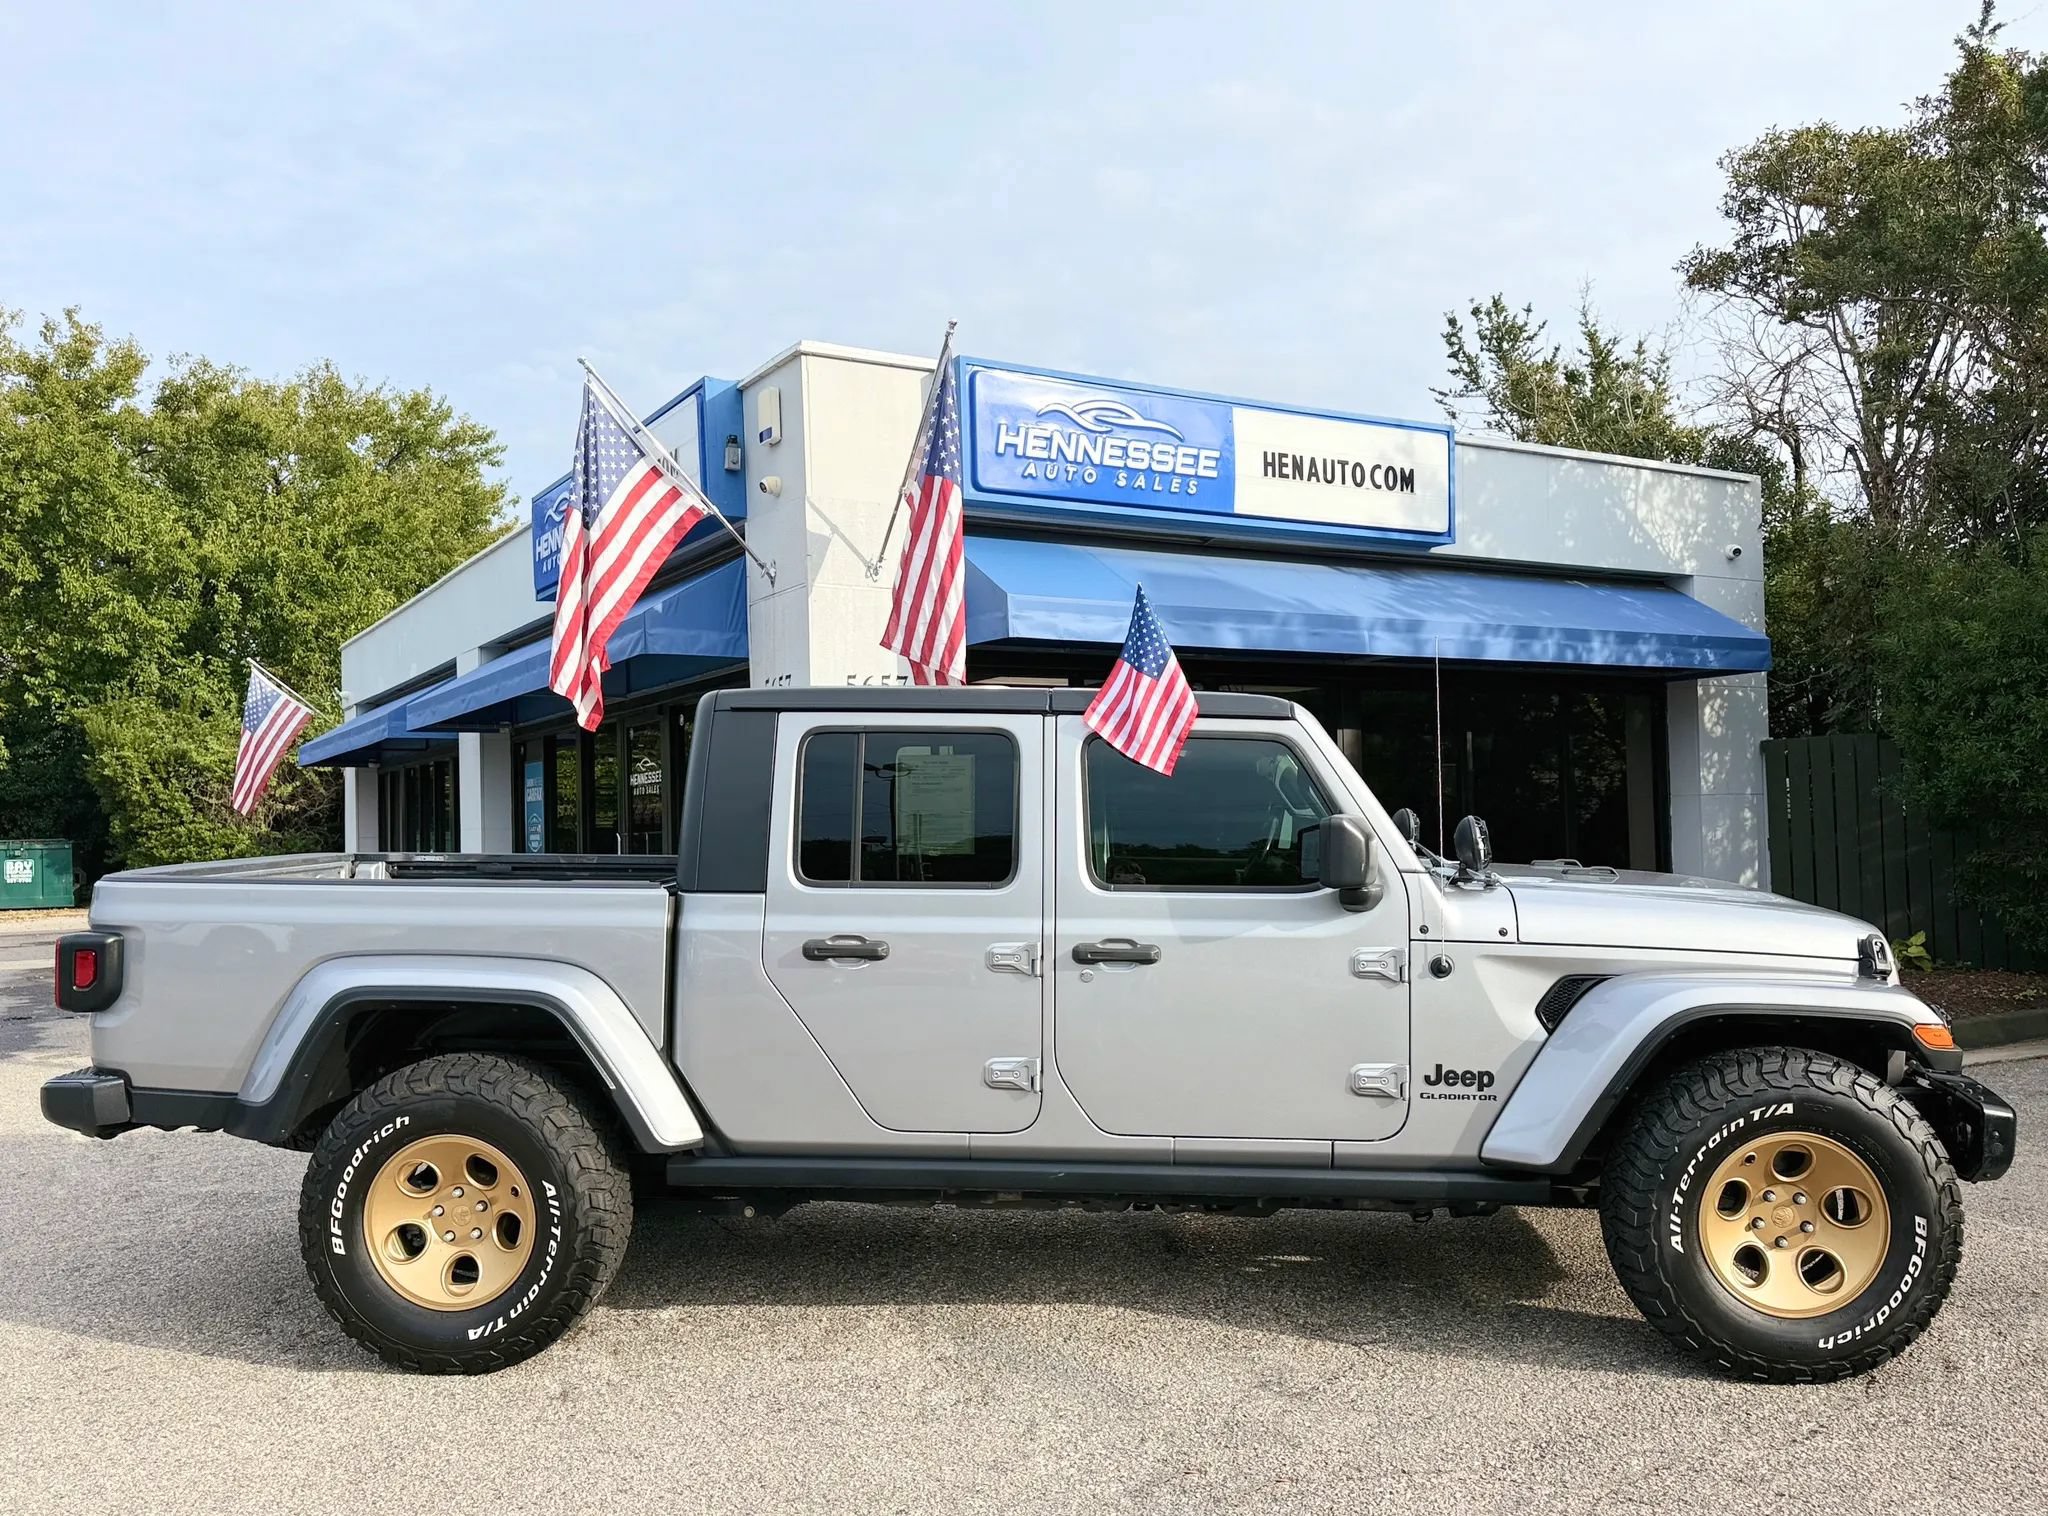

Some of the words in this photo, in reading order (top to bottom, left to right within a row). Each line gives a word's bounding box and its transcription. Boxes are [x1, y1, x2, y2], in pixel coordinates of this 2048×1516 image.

[996, 423, 1221, 478] HENNESSEE
[1022, 461, 1098, 484] AUTO
[1115, 471, 1199, 495] SALES
[630, 769, 662, 786] HENNESSEE
[1420, 1092, 1498, 1101] GLADIATOR
[1424, 1063, 1495, 1092] Jeep
[331, 1115, 410, 1256] BFGoodrich
[1670, 1117, 1745, 1253] All-Terrain
[1750, 1102, 1794, 1122] T/A
[510, 1179, 561, 1320] All-Terrain
[1818, 1214, 1928, 1350] BFGoodrich
[467, 1315, 508, 1341] T/A
